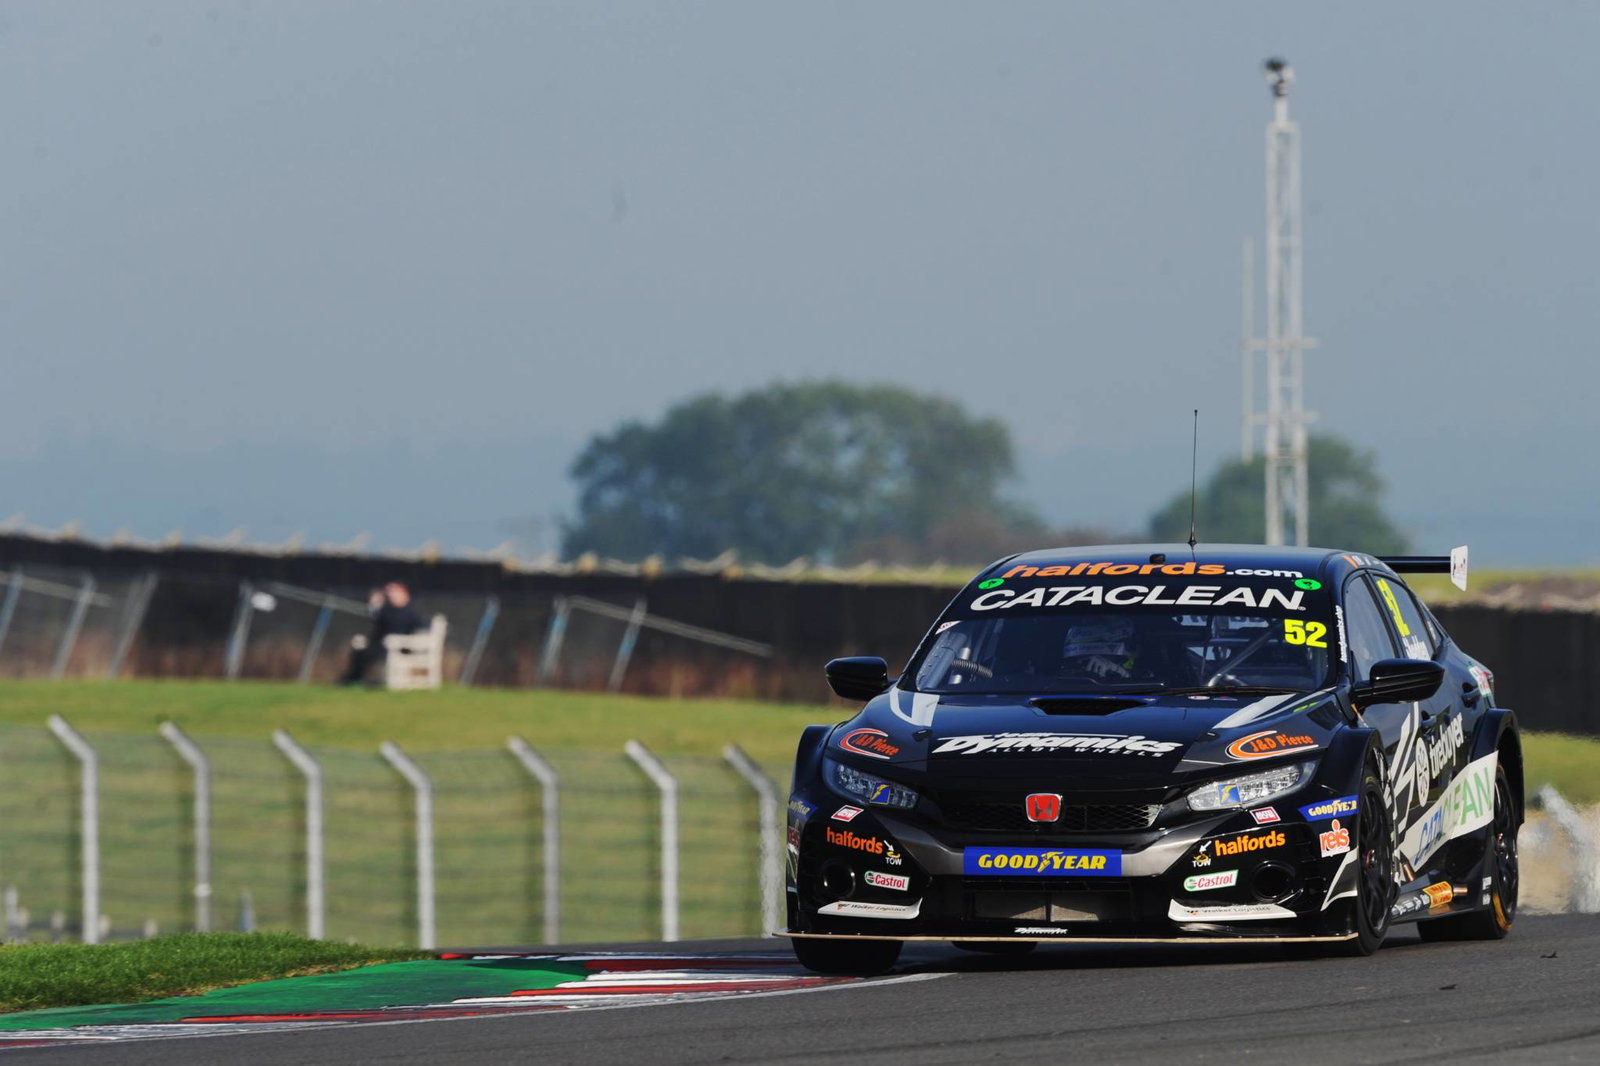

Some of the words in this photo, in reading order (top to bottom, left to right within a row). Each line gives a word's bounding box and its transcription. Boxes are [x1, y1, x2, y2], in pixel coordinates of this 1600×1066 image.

[1002, 562, 1303, 578] halfords.com
[970, 586, 1305, 611] CATACLEAN
[1284, 619, 1328, 648] 52
[932, 735, 1183, 755] Dynamics
[1250, 737, 1277, 752] J&D
[1276, 734, 1314, 747] Pierce
[1430, 712, 1464, 779] tirebuyer
[826, 826, 884, 854] halfords
[1214, 830, 1286, 856] halfords
[1320, 819, 1350, 850] reis
[885, 857, 902, 866] TOW
[1192, 859, 1211, 867] TOW
[875, 874, 905, 888] Castrol
[1197, 873, 1233, 888] Castrol
